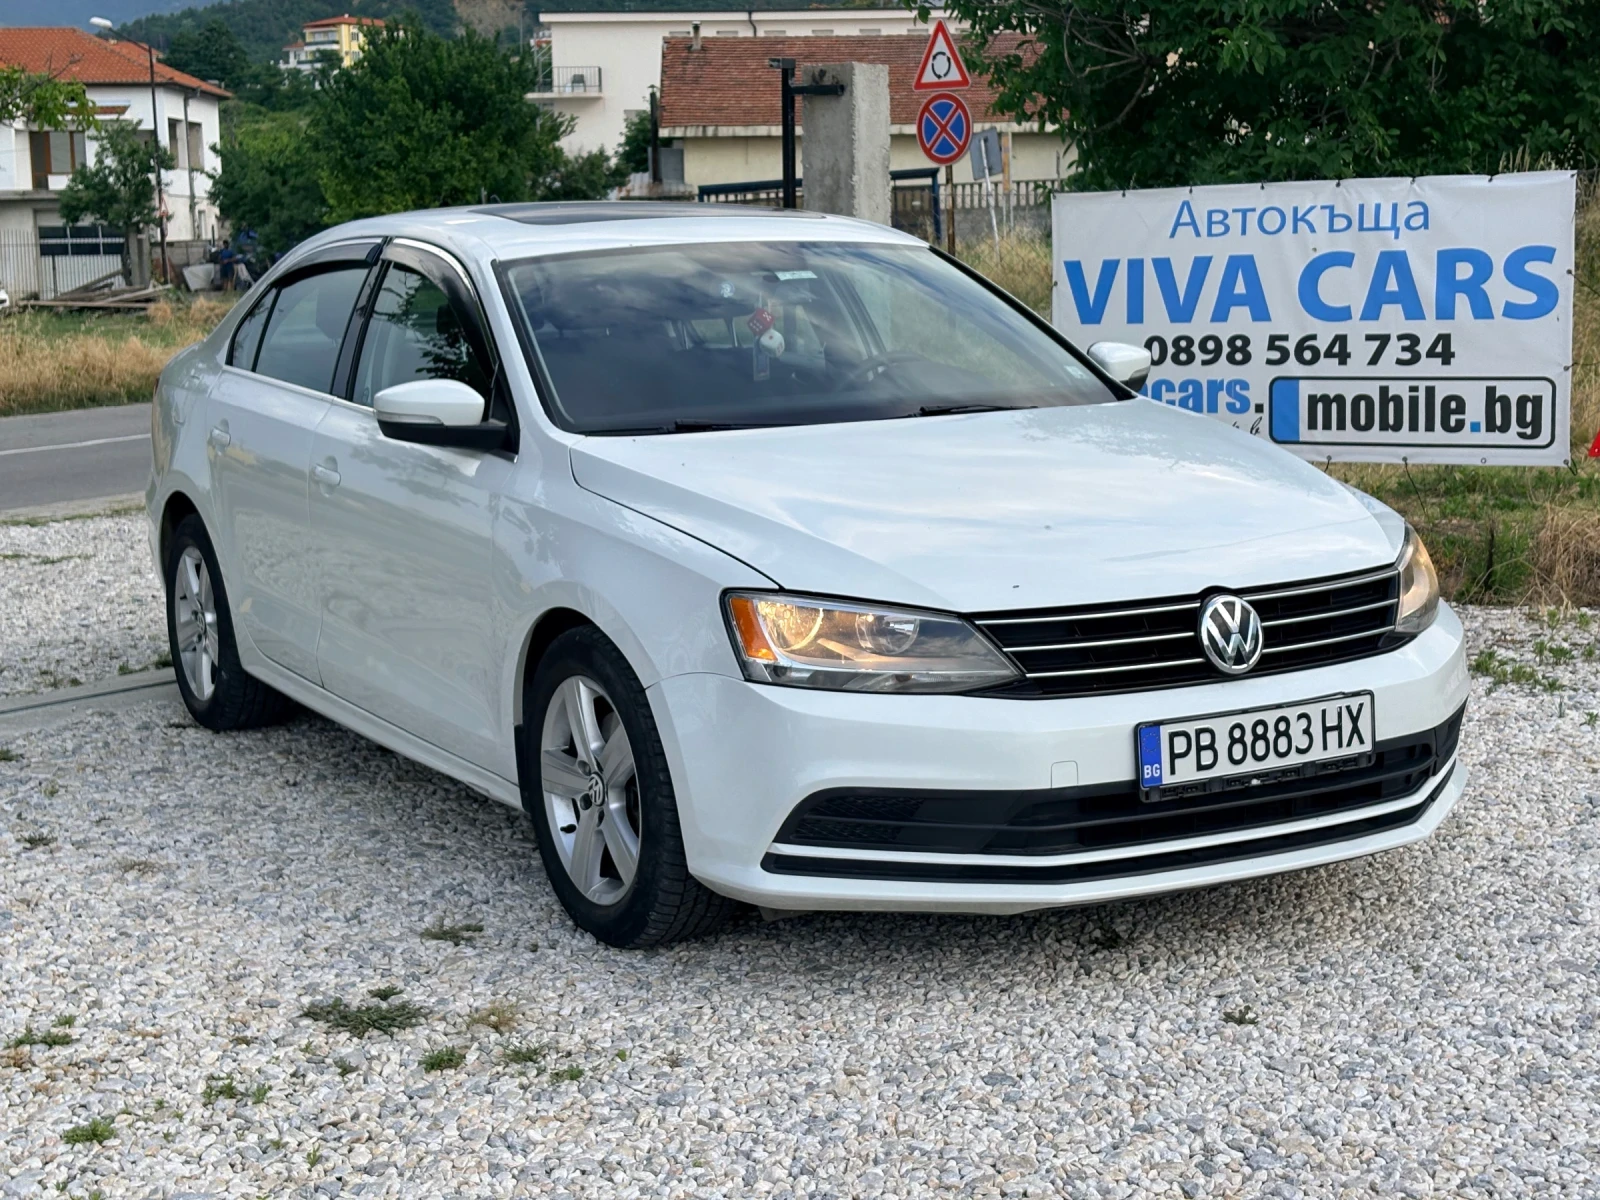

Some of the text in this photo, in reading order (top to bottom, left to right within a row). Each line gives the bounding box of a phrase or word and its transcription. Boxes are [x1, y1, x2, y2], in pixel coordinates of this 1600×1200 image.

[1169, 200, 1430, 239] Автокъща
[1064, 245, 1559, 325] VIVA CARS
[1144, 333, 1455, 366] 0898 564 734
[1307, 385, 1543, 440] mobile.bg
[1167, 702, 1365, 775] PB 8883 HX
[1144, 764, 1161, 779] BG
